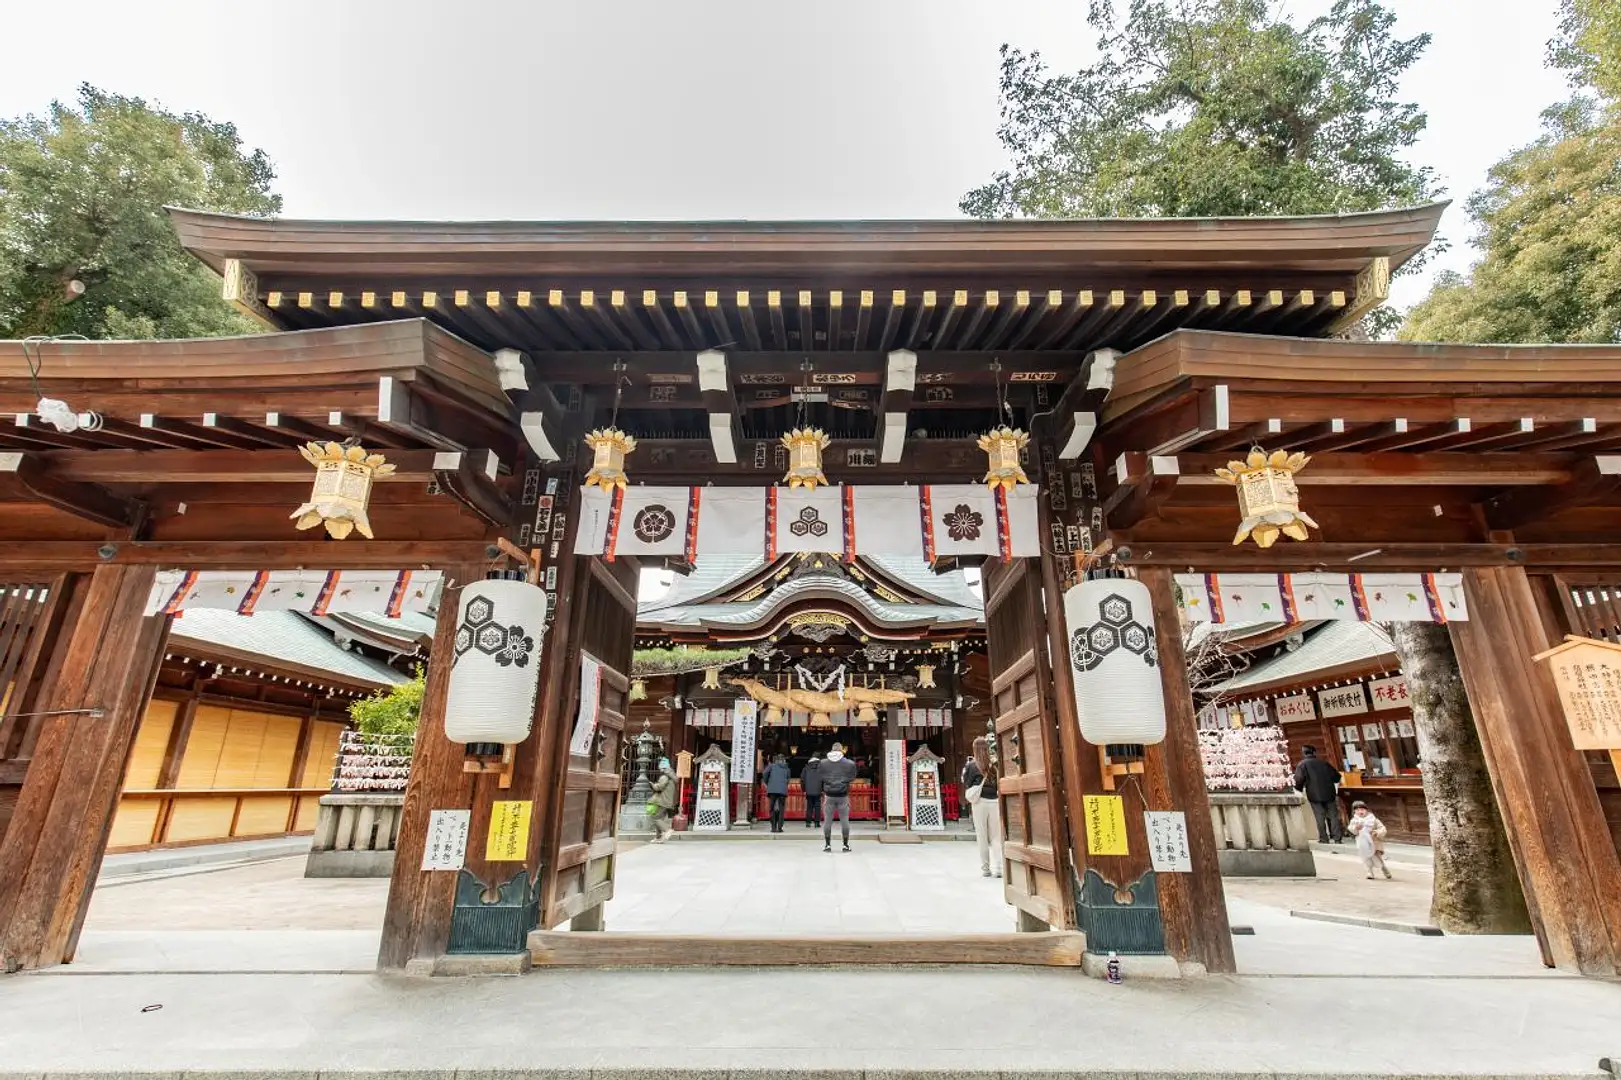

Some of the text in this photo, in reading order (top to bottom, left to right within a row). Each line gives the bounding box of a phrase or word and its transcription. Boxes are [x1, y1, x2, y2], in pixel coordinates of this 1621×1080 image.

[1280, 701, 1311, 716] おみくじ
[430, 817, 445, 860] 出入り禁止
[1152, 818, 1165, 862] 出入り禁止
